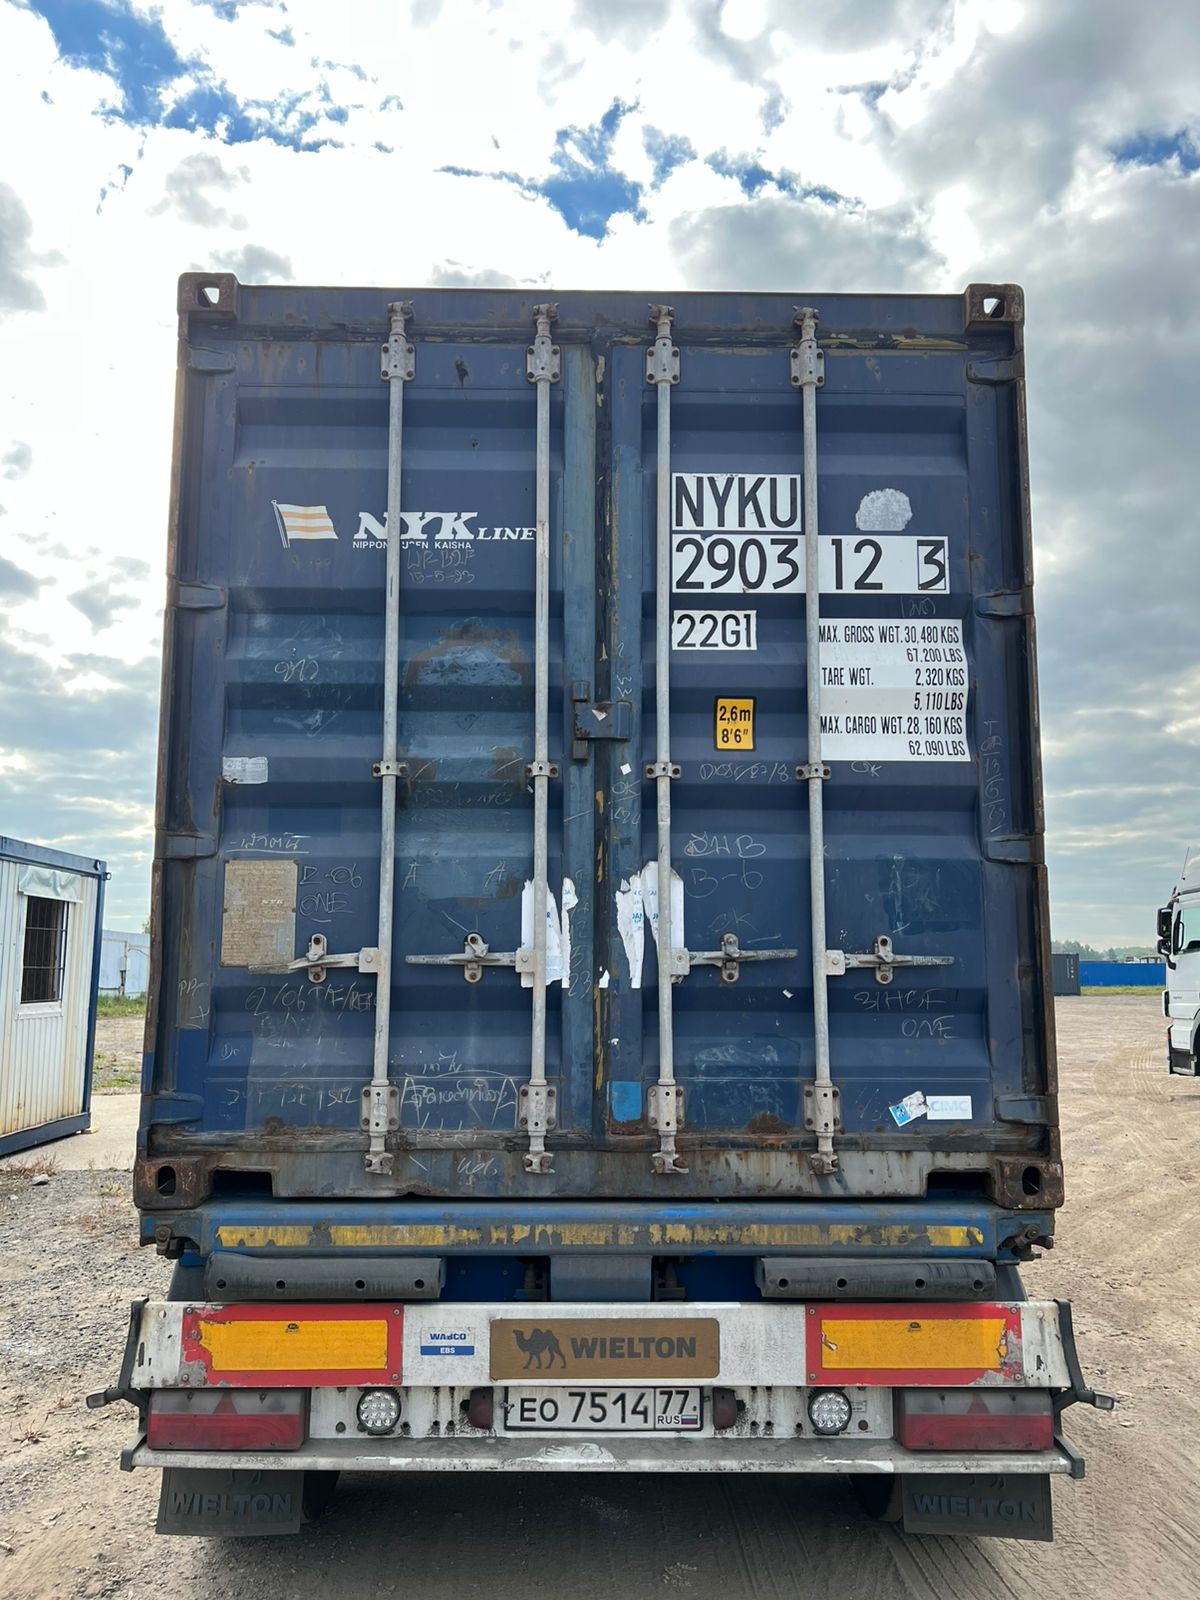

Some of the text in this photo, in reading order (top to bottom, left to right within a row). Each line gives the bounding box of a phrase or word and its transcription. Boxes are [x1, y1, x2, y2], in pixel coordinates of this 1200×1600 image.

[675, 476, 798, 529] NYKU
[476, 527, 537, 540] LINE
[434, 541, 472, 549] KAISHA
[917, 539, 946, 591] 3
[676, 613, 752, 648] 22G1
[819, 625, 959, 644] MAX. GROSS WGT. 30,480 KGS
[906, 647, 963, 663] 67,200 LBS
[822, 667, 965, 687] TARE WGT. 2,320 KGS
[944, 692, 964, 711] LBS
[820, 716, 843, 735] MAX.
[845, 716, 877, 734] CARGO
[880, 716, 906, 735] WGT.
[944, 717, 963, 735] KGS
[908, 740, 944, 756] 62,090
[945, 740, 966, 756] LBS
[570, 1336, 697, 1359] WIELTON
[568, 1391, 649, 1424] 7514
[658, 1389, 690, 1415] 77
[657, 1414, 680, 1425] RUS
[172, 1492, 292, 1515] WIELTON
[912, 1493, 1038, 1522] WIELTON
